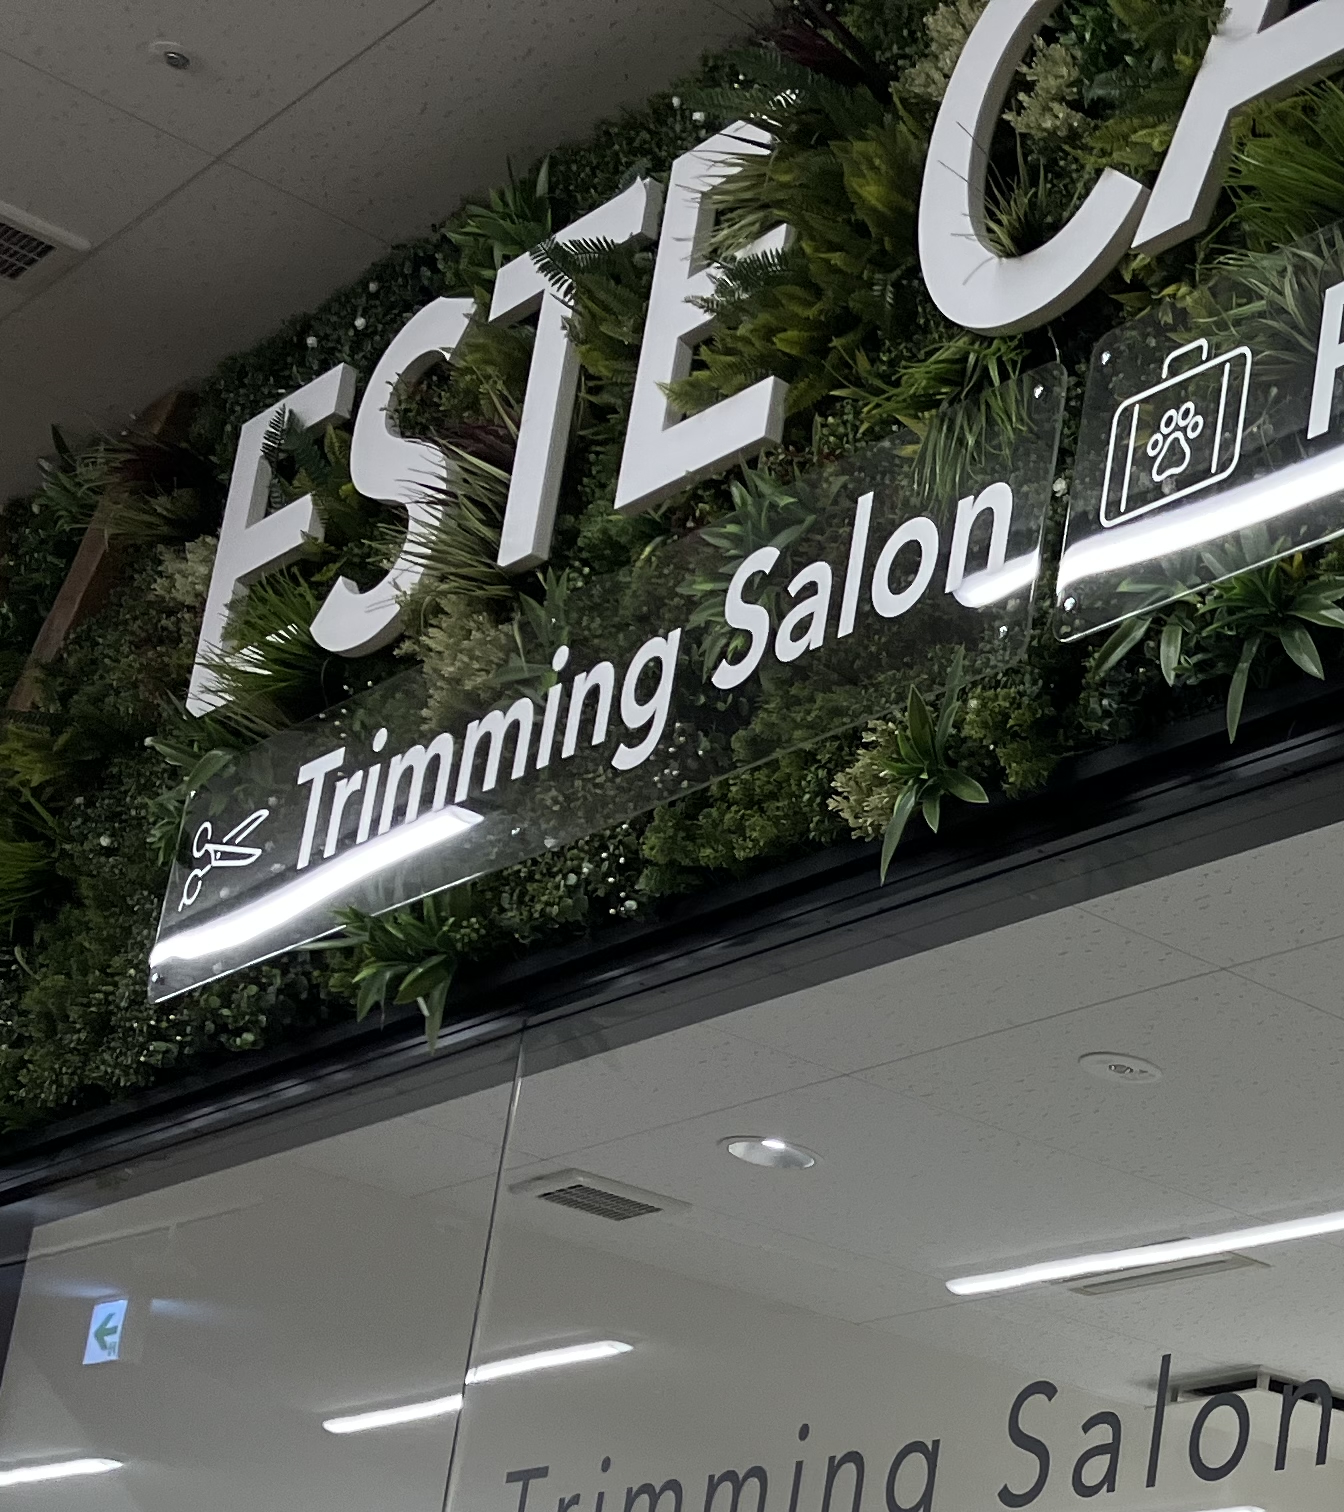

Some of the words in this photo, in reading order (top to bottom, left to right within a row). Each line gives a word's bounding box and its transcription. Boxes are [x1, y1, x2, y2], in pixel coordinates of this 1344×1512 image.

[186, 119, 789, 718] ESTE
[297, 628, 681, 870] Trimming
[712, 482, 1015, 689] Salon
[998, 1354, 1333, 1508] Salon
